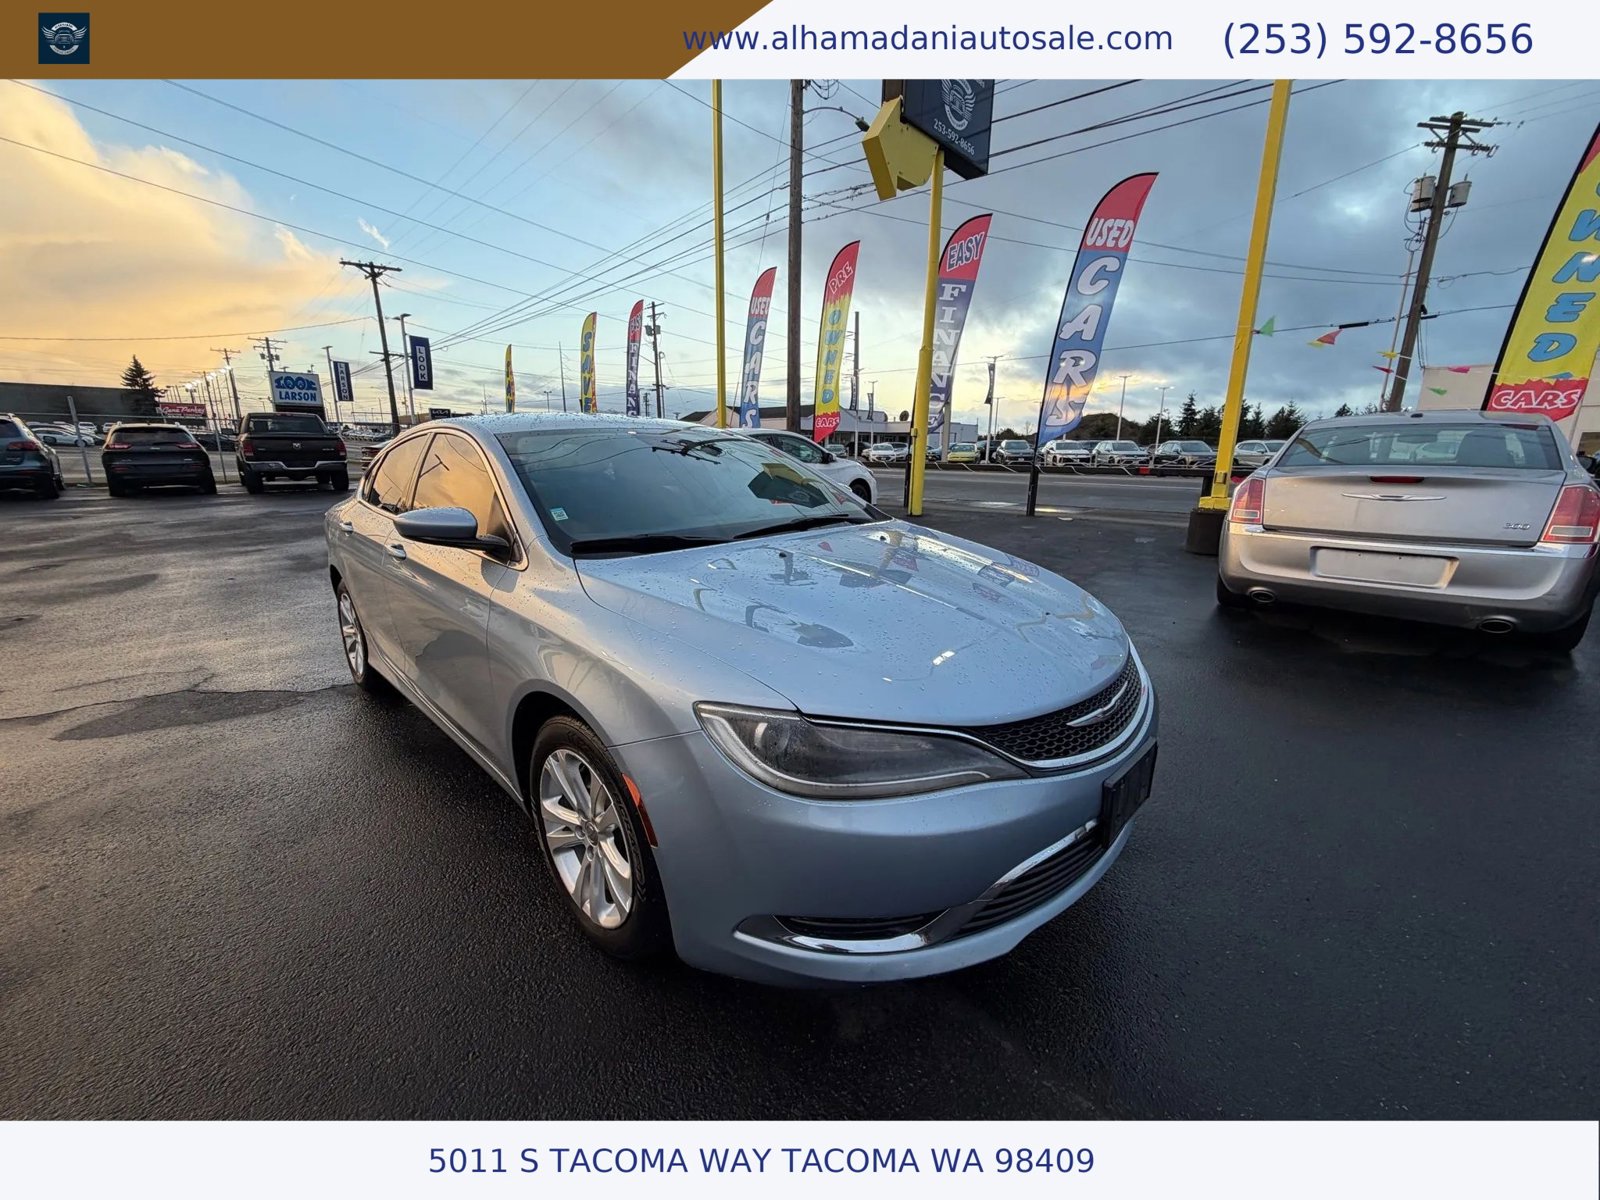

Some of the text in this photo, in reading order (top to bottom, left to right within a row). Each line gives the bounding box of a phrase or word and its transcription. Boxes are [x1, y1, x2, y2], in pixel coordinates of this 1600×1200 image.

[933, 118, 975, 156] 253-592-8656
[1086, 217, 1134, 248] USED
[946, 231, 984, 272] EASY
[829, 261, 854, 294] PRE
[1527, 181, 1600, 362] WNED
[821, 309, 843, 404] OWNED
[927, 283, 967, 428] FINANCE
[1045, 255, 1121, 427] CARS
[338, 363, 350, 400] LARSON
[417, 346, 428, 381] LOOK
[742, 320, 767, 428] CARS
[279, 391, 317, 401] LARSON
[1492, 389, 1581, 410] CARS
[815, 416, 840, 428] CARS
